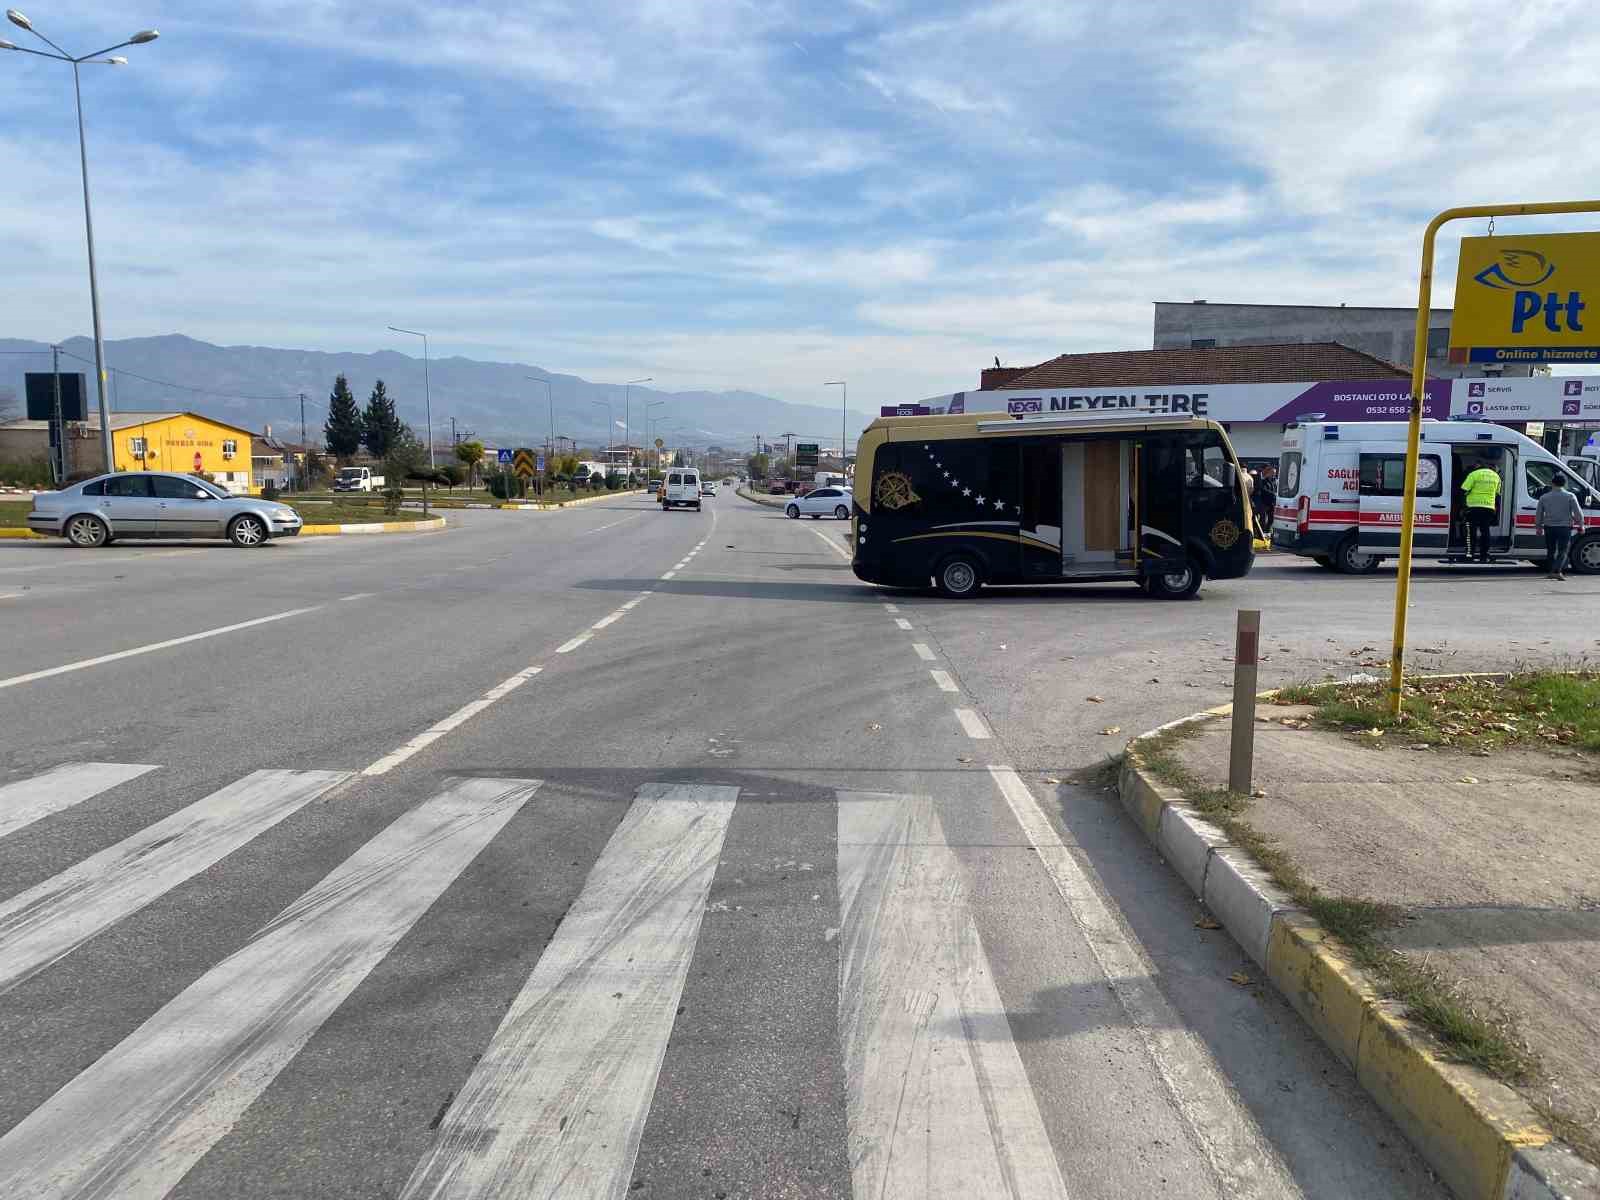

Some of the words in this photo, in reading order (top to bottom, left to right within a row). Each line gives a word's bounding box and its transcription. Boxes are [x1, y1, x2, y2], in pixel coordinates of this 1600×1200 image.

[1511, 291, 1586, 333] Ptt
[1495, 350, 1538, 360] Online
[1543, 349, 1597, 360] hizmete
[1144, 393, 1209, 415] TIRE
[1379, 393, 1398, 401] OTO
